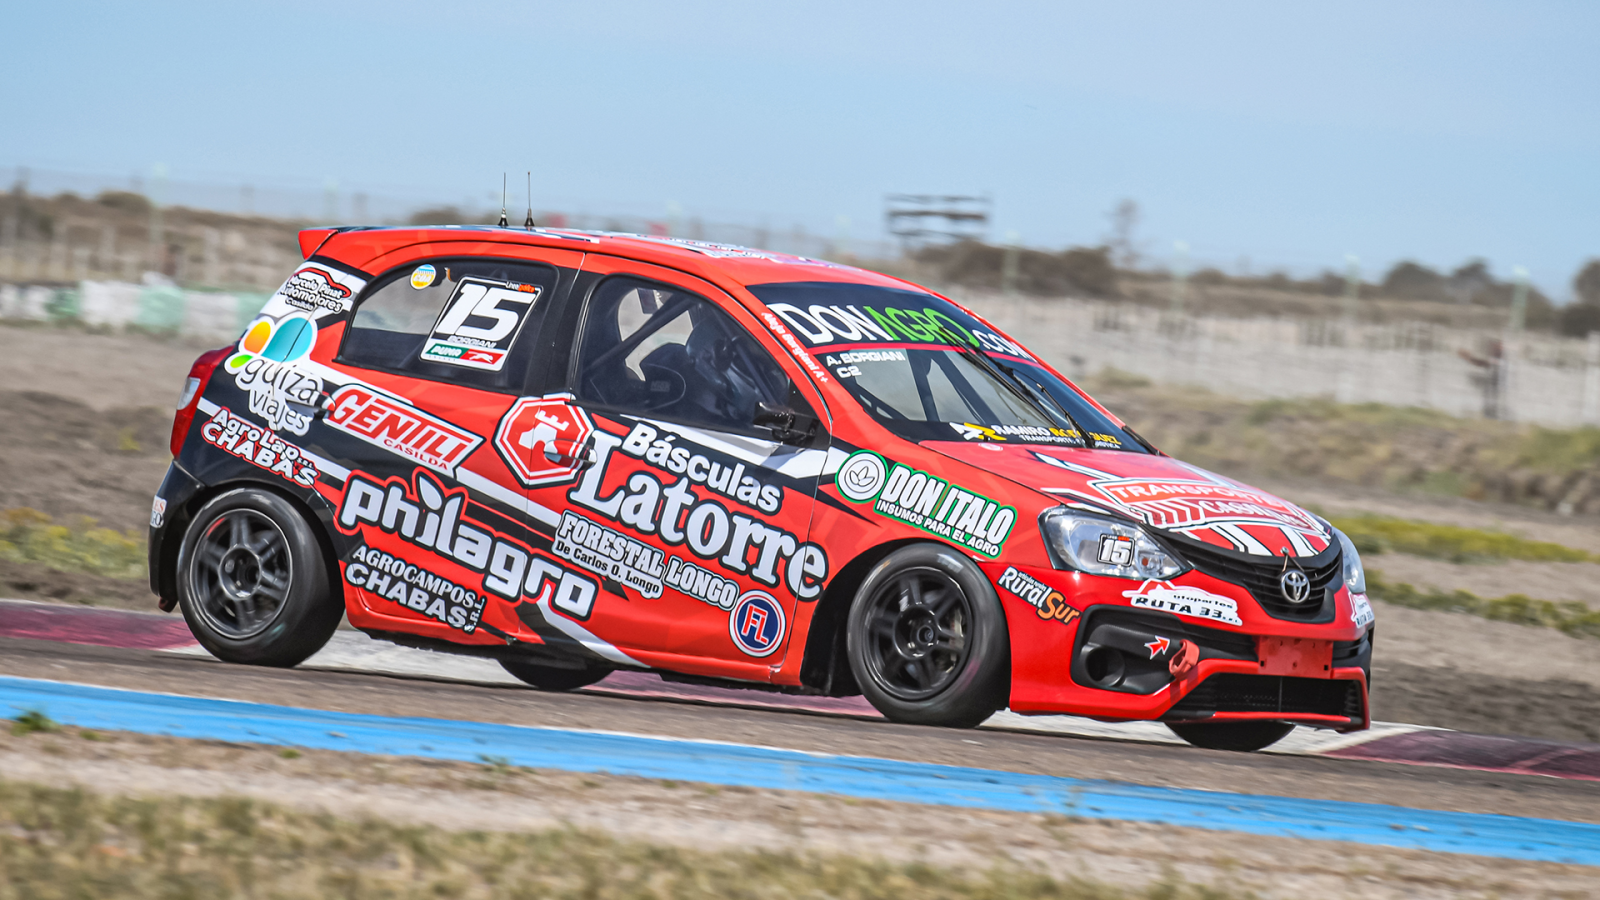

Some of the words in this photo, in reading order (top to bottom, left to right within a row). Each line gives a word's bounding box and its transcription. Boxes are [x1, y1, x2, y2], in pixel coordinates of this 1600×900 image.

[435, 283, 536, 342] 15
[253, 389, 305, 429] viajes
[991, 425, 1050, 436] RAMIRO
[1049, 427, 1122, 445] RODUEZ
[383, 438, 448, 470] CASILDA
[623, 422, 782, 512] Básculas
[570, 430, 827, 598] Latorre
[876, 500, 923, 525] INSUMOS
[924, 518, 951, 537] PARA
[952, 531, 966, 543] EL
[967, 535, 1000, 556] AGRO
[879, 465, 947, 517] DON
[935, 486, 1015, 545] ITALO
[341, 476, 596, 618] philagro
[556, 540, 570, 555] De
[573, 547, 608, 571] Carlos
[611, 564, 621, 578] O.
[625, 570, 660, 594] Longo
[558, 513, 664, 579] FORESTAL
[664, 559, 738, 608] LONGO
[1101, 539, 1132, 564] 15
[346, 563, 468, 628] CHABAS
[352, 545, 476, 608] AGROCAMPOS
[743, 604, 769, 644] FL
[1135, 597, 1192, 614] RUTA
